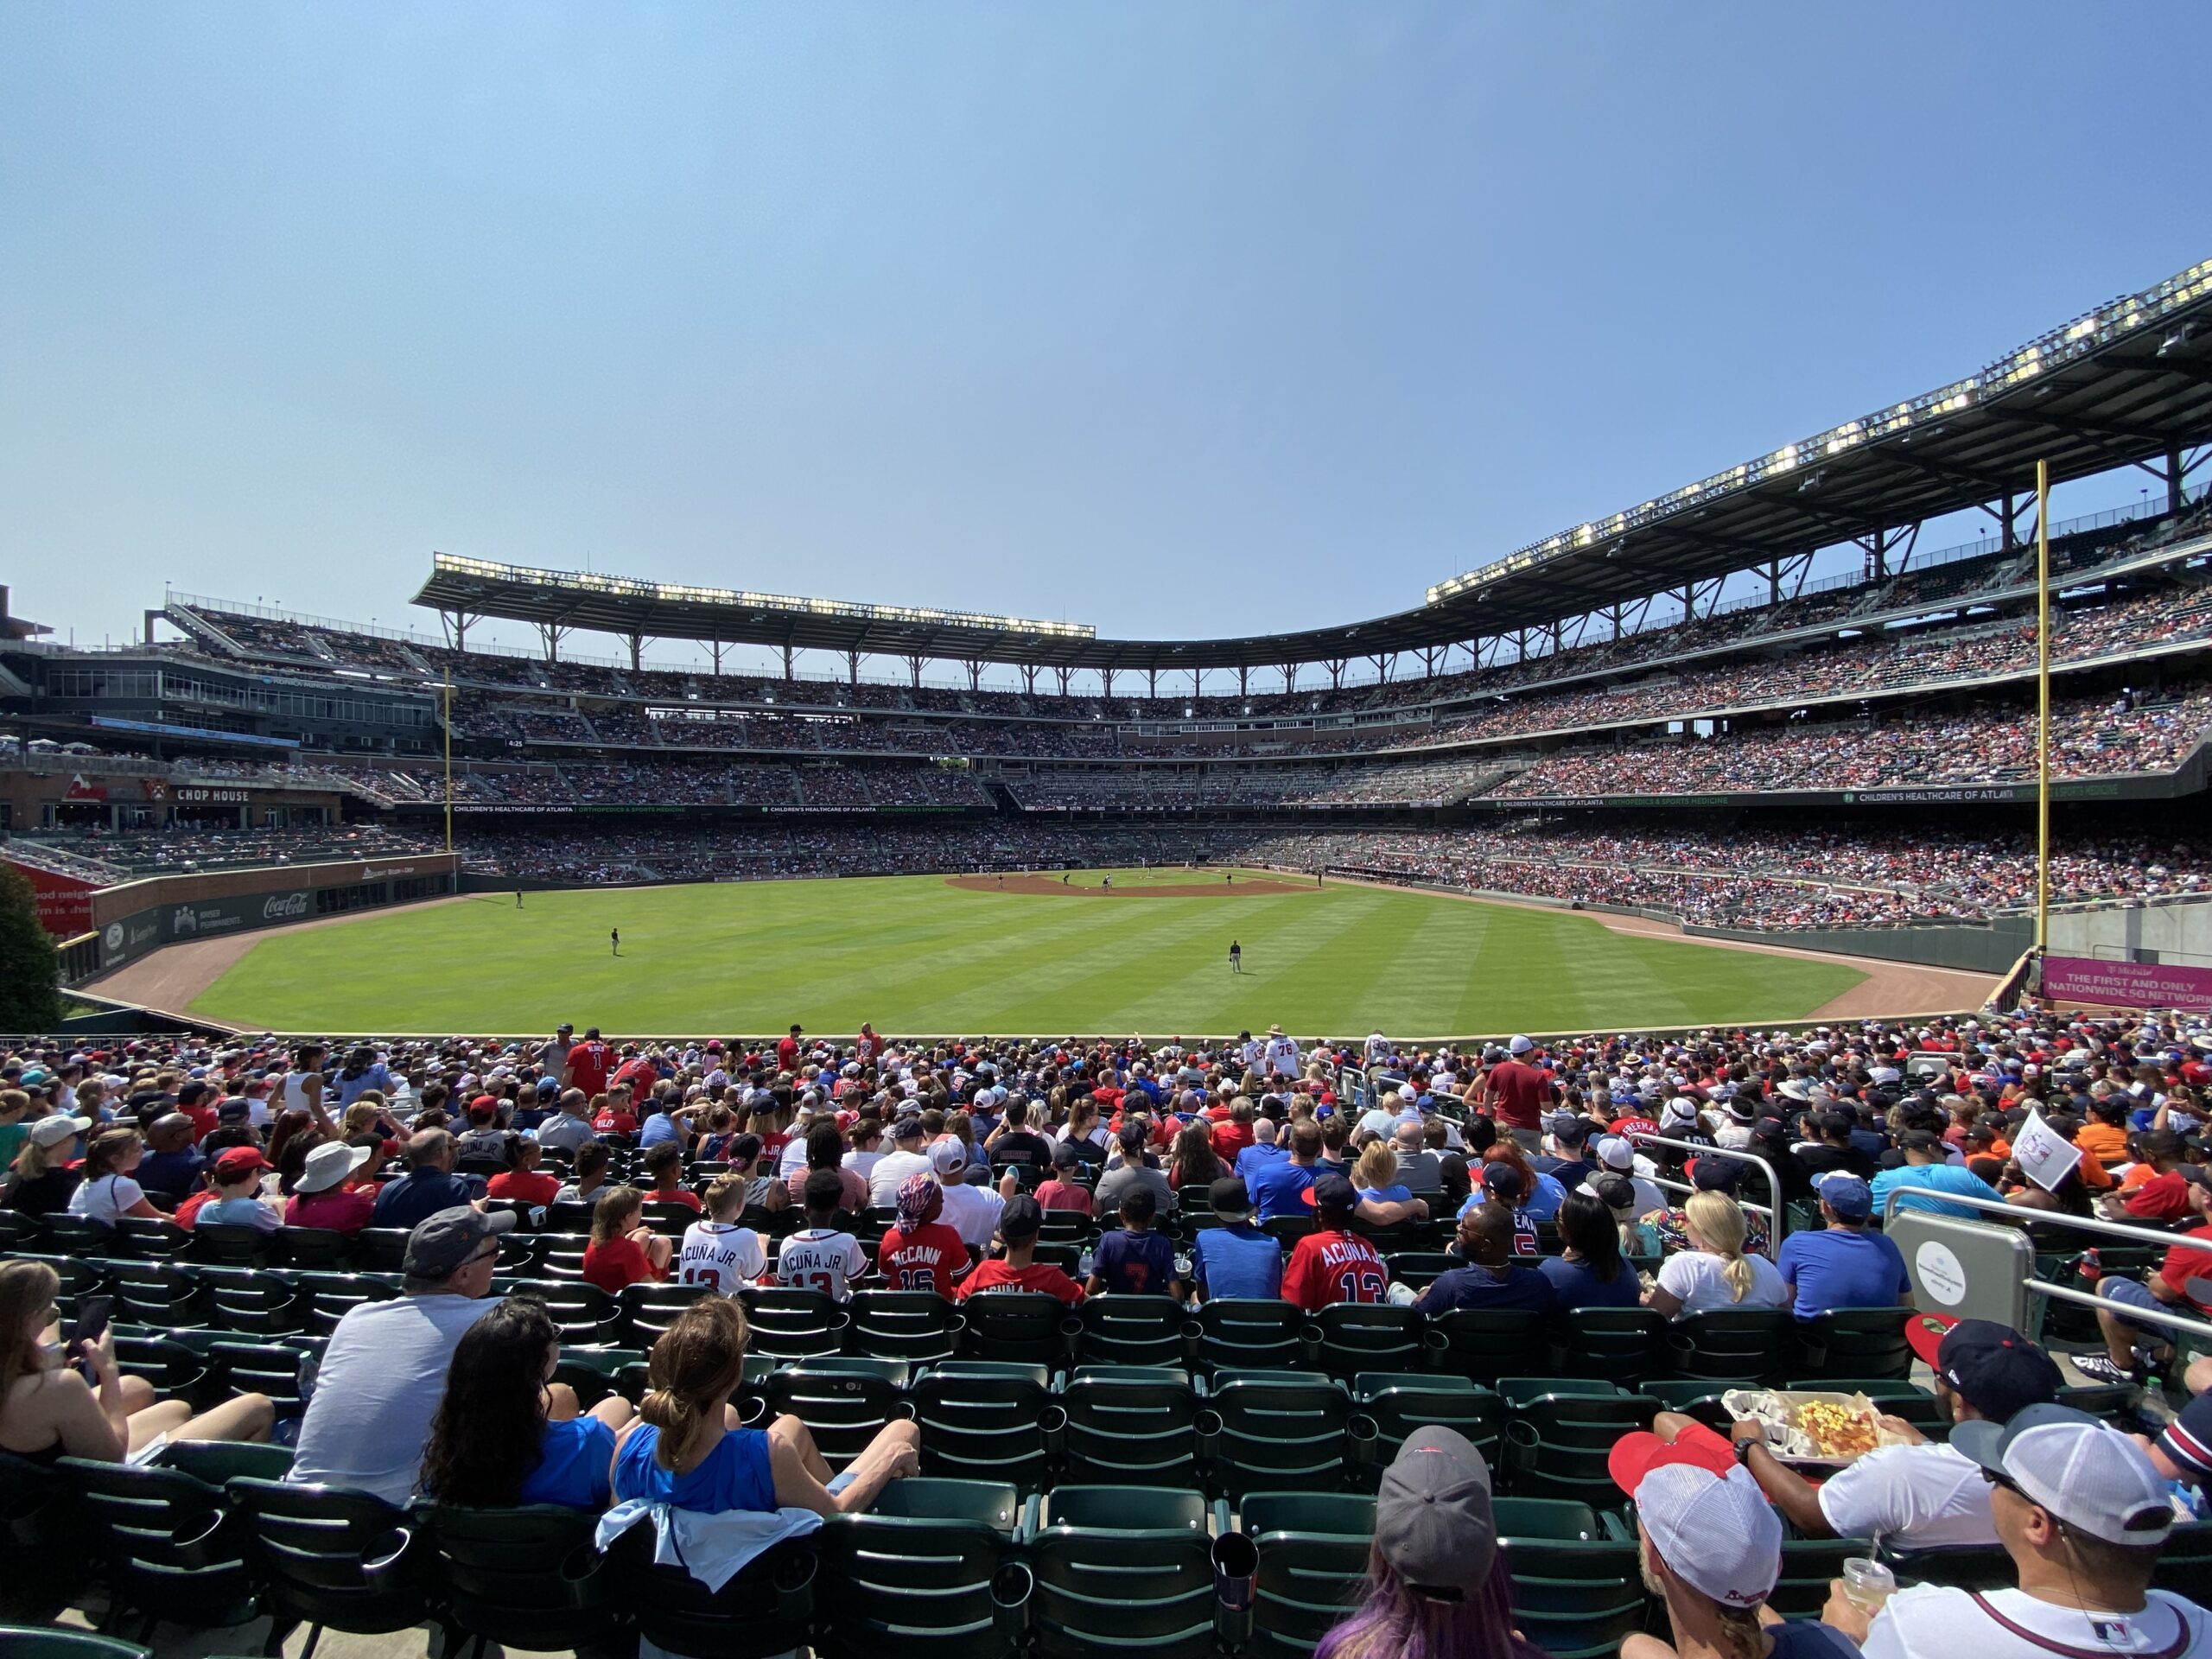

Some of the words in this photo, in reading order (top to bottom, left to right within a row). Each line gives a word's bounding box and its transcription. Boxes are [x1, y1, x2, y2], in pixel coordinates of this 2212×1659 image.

[177, 789, 209, 801] CHOP
[213, 790, 250, 802] HOUSE
[1859, 792, 1904, 802] CHILDREN'S
[1905, 791, 1961, 801] HEALTHCARE
[1964, 790, 1978, 799] OF
[1980, 789, 2013, 799] ATLANTA
[33, 891, 55, 899] ood
[264, 893, 308, 918] Coca-Cola
[2048, 981, 2127, 997] NATIONWIDE
[2129, 988, 2148, 999] 5G
[2148, 991, 2212, 1005] NETWORK
[2066, 973, 2092, 984] THE
[2093, 975, 2129, 987] FIRST
[2131, 978, 2158, 989] AND
[2161, 981, 2196, 993] ONLY
[594, 1052, 601, 1070] 1
[1278, 1043, 1293, 1056] 76
[952, 1076, 966, 1092] 5
[597, 1119, 615, 1128] RILEY
[1623, 1122, 1660, 1136] FREEMAN
[680, 1243, 714, 1263] ACUÑA
[717, 1249, 737, 1268] JR.
[785, 1250, 821, 1273] ACUÑA
[824, 1254, 842, 1270] JR.
[1320, 1238, 1372, 1268] ACUÑA
[684, 1268, 720, 1293] 13
[792, 1271, 833, 1297] 13
[899, 1268, 935, 1292] 16
[1125, 1262, 1148, 1294] 7
[1340, 1272, 1388, 1304] 13
